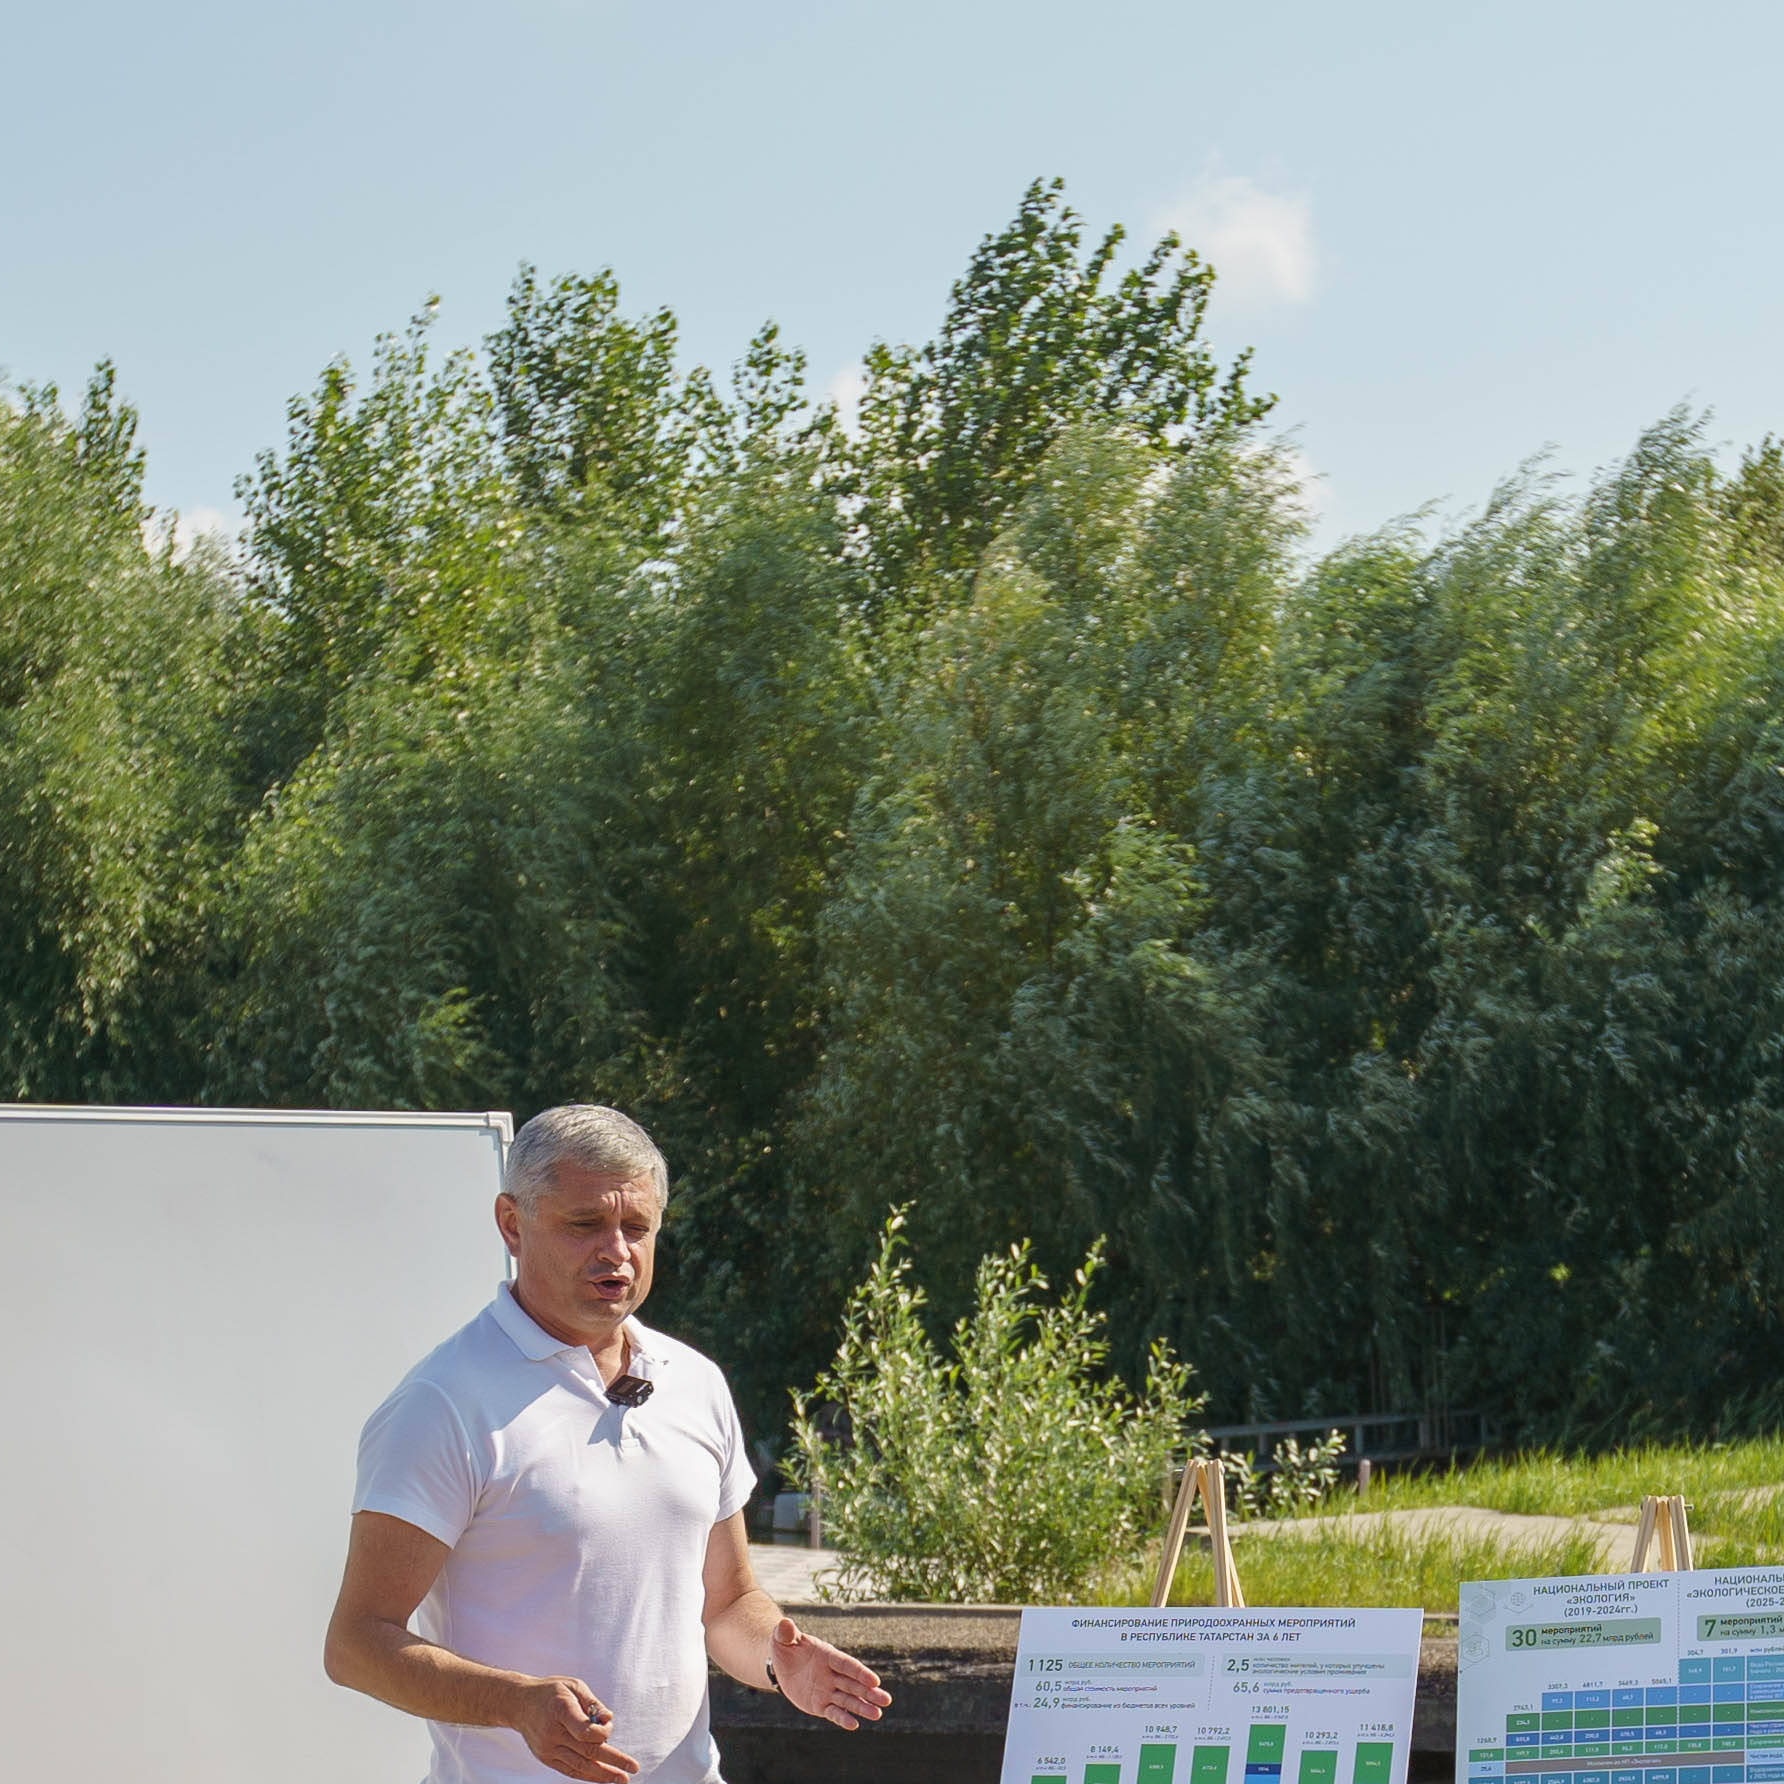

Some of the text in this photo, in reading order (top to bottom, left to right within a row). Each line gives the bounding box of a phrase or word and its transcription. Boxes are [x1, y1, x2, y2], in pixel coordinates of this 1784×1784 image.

[1533, 1579, 1670, 1596] НАЦИОНАЛЬНЫЙ ПРОЕКТ
[1566, 1592, 1636, 1605] «ЭКОЛОГИЯ»
[1564, 1604, 1638, 1618] (2019-2024гг.)
[1071, 1617, 1356, 1629] ФИНАНСИРОВАНИЕ ПРИРОДООХРАННЫХ МЕРОПРИЯТИЙ
[1720, 1614, 1783, 1626] мероприятий
[1541, 1623, 1603, 1635] мероприятий
[1704, 1619, 1716, 1638] 7
[1720, 1629, 1730, 1637] на
[1731, 1628, 1756, 1637] сумму
[1760, 1625, 1776, 1635] 1,3
[1120, 1632, 1302, 1642] В РЕСПУБЛИКЕ ТАТАРСТАН ЗА 6 ЛЕТ
[1511, 1629, 1537, 1648] 30
[1552, 1637, 1577, 1647] сумму
[1579, 1634, 1602, 1644] 22,7
[1624, 1631, 1654, 1643] рублей
[1039, 1659, 1063, 1672] 125
[1068, 1661, 1093, 1669] ОБЩЕЕ
[1094, 1661, 1141, 1669] КОЛИЧЕСТВО
[1142, 1660, 1196, 1669] МЕРОПРИЯТИЙ
[1226, 1658, 1249, 1673] 2,5
[1035, 1680, 1062, 1693] 60,5
[1232, 1681, 1260, 1695] 65,6
[1033, 1697, 1060, 1709] 24,9
